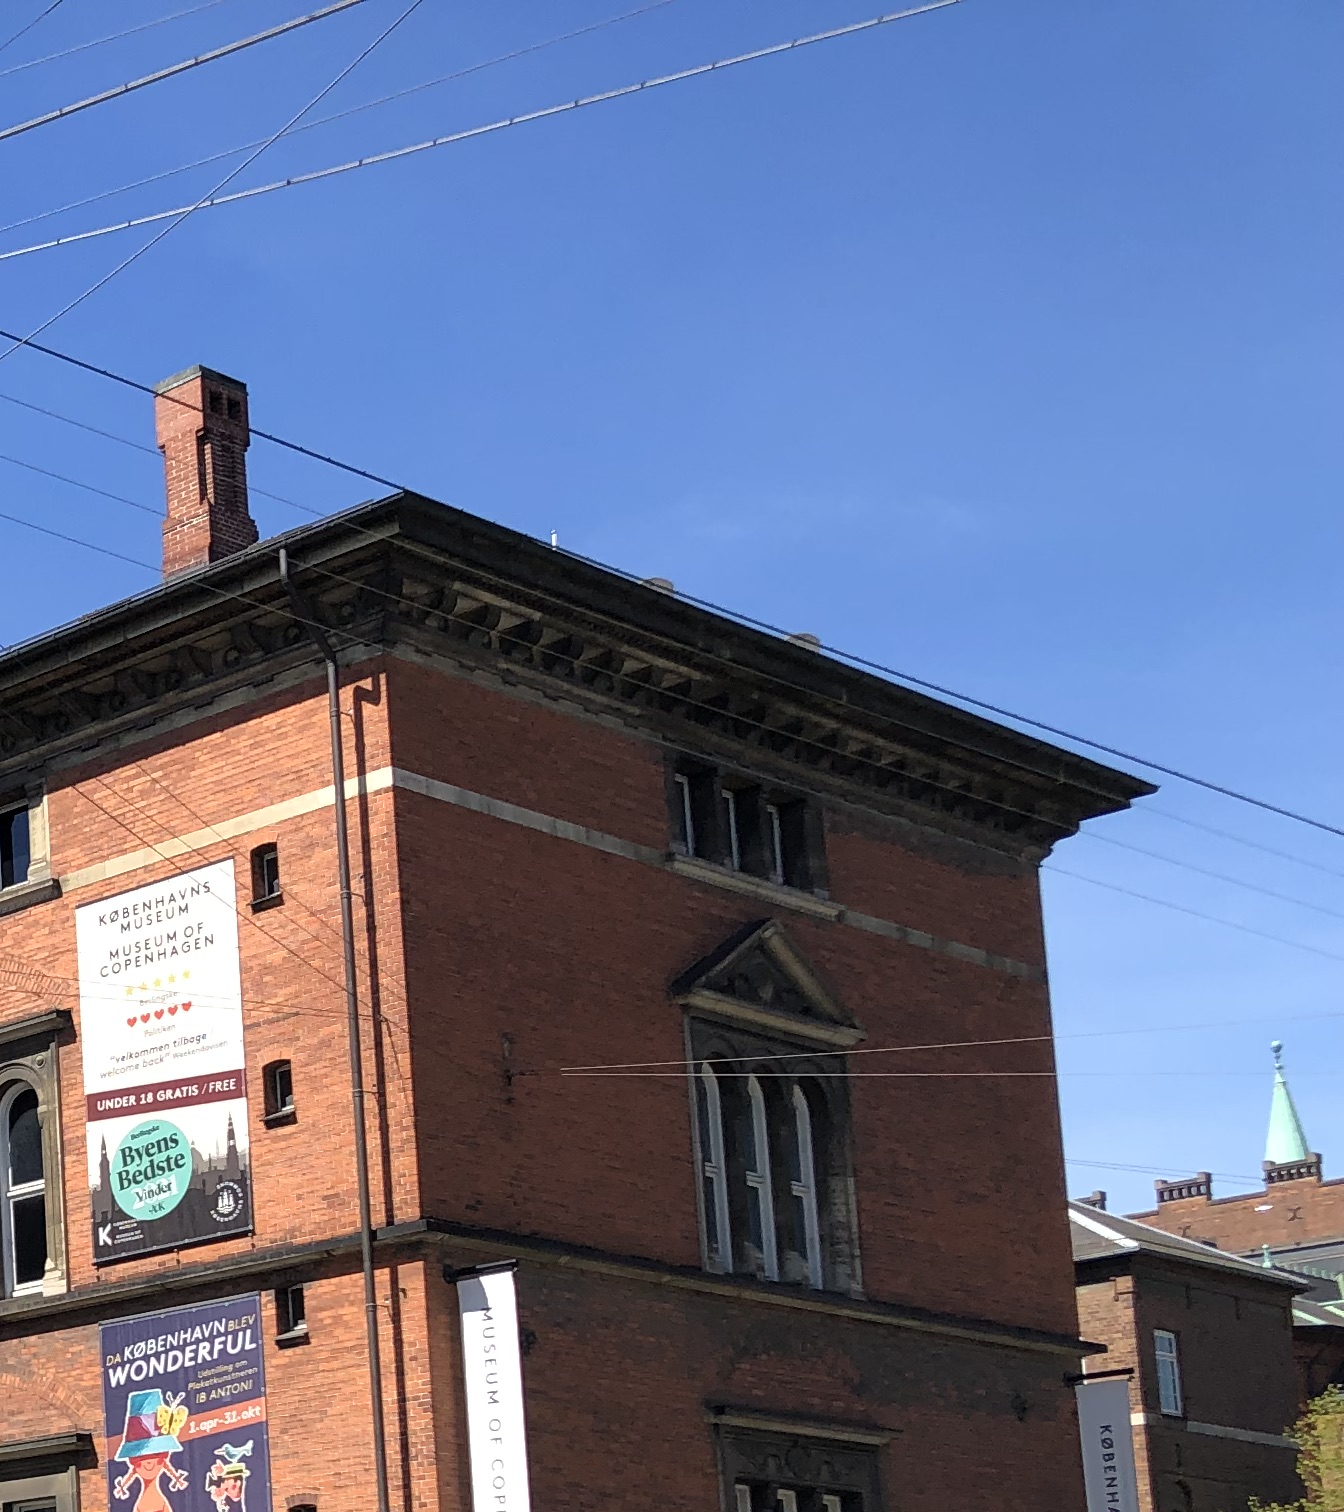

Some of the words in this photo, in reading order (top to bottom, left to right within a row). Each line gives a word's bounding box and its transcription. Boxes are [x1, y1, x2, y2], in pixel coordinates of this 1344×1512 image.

[98, 880, 211, 927] KØBENHAVNS
[120, 902, 189, 934] MUSEUM
[99, 933, 214, 978] COPENHAGEN
[109, 930, 177, 961] MUSEUM
[183, 921, 204, 938] OF
[144, 1024, 176, 1037] Politiken
[172, 1033, 207, 1048] tilbage
[99, 1062, 140, 1079] welcome
[96, 1094, 137, 1111] UNDER
[139, 1092, 154, 1105] 18
[156, 1084, 199, 1102] GRATIS
[208, 1078, 237, 1094] FREE
[119, 1132, 180, 1169] Byens
[116, 1152, 187, 1192] Bedste
[135, 1181, 173, 1203] Vinder
[98, 1222, 113, 1247] K
[106, 1352, 122, 1367] DA
[123, 1317, 227, 1362] KØBENHAVN
[227, 1313, 256, 1332] BLEV
[480, 1306, 501, 1405] MUSEUM
[108, 1328, 258, 1388] WONDERFUL
[196, 1391, 207, 1404] IB
[209, 1379, 254, 1401] ANTONI
[488, 1417, 503, 1446] OF
